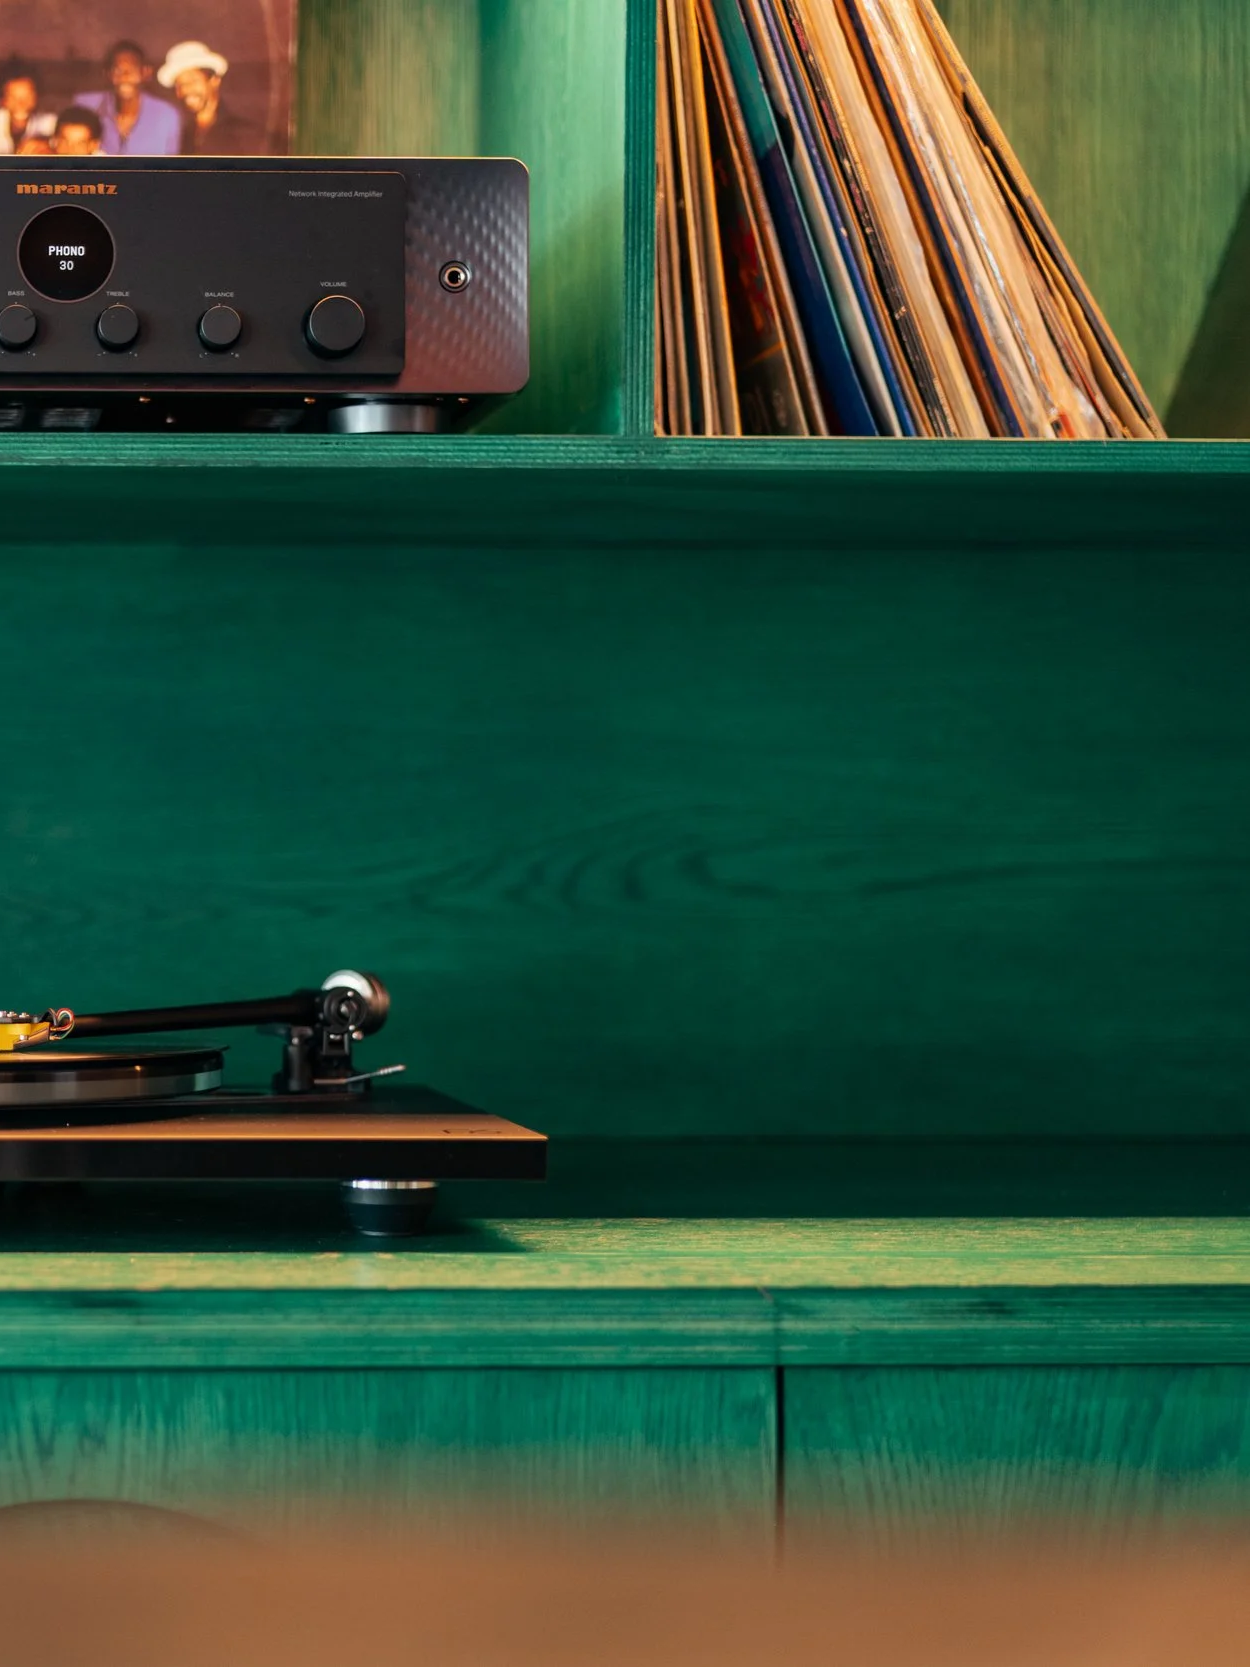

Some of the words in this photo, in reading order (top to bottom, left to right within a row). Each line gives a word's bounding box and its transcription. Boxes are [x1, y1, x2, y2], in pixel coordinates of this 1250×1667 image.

[16, 183, 118, 195] marantz
[288, 190, 316, 198] Network
[317, 190, 352, 199] Integrated
[353, 190, 383, 199] Amplifier
[48, 246, 85, 256] PHONO
[59, 260, 74, 271] 30
